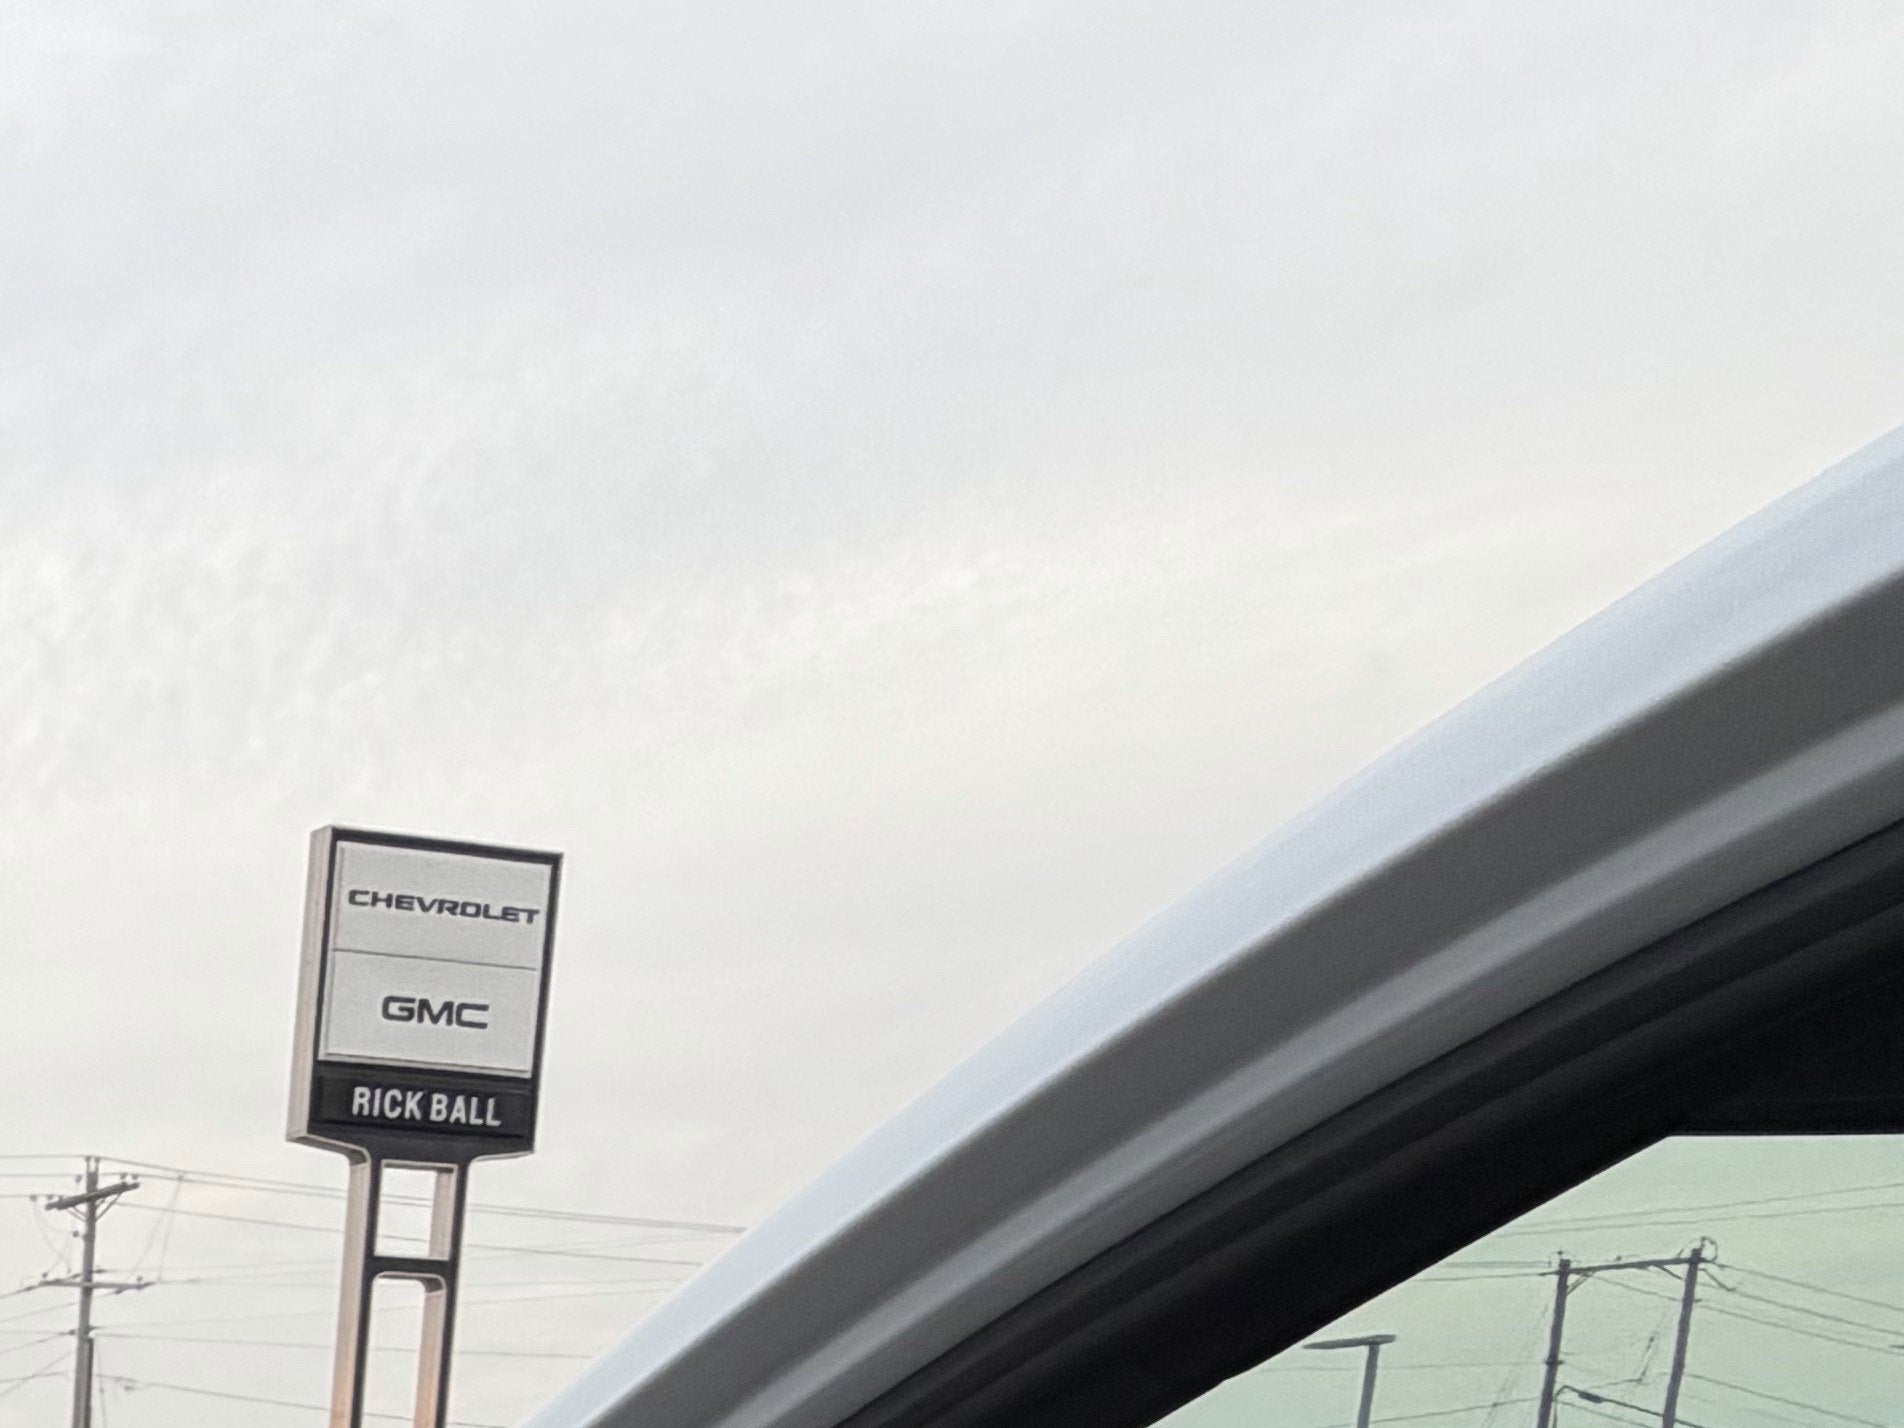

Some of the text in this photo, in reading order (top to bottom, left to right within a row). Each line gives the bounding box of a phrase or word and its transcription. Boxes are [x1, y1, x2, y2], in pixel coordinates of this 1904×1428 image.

[347, 888, 541, 924] CHEVROLET
[381, 995, 490, 1030] GMC
[351, 1085, 502, 1127] RICK BALL
